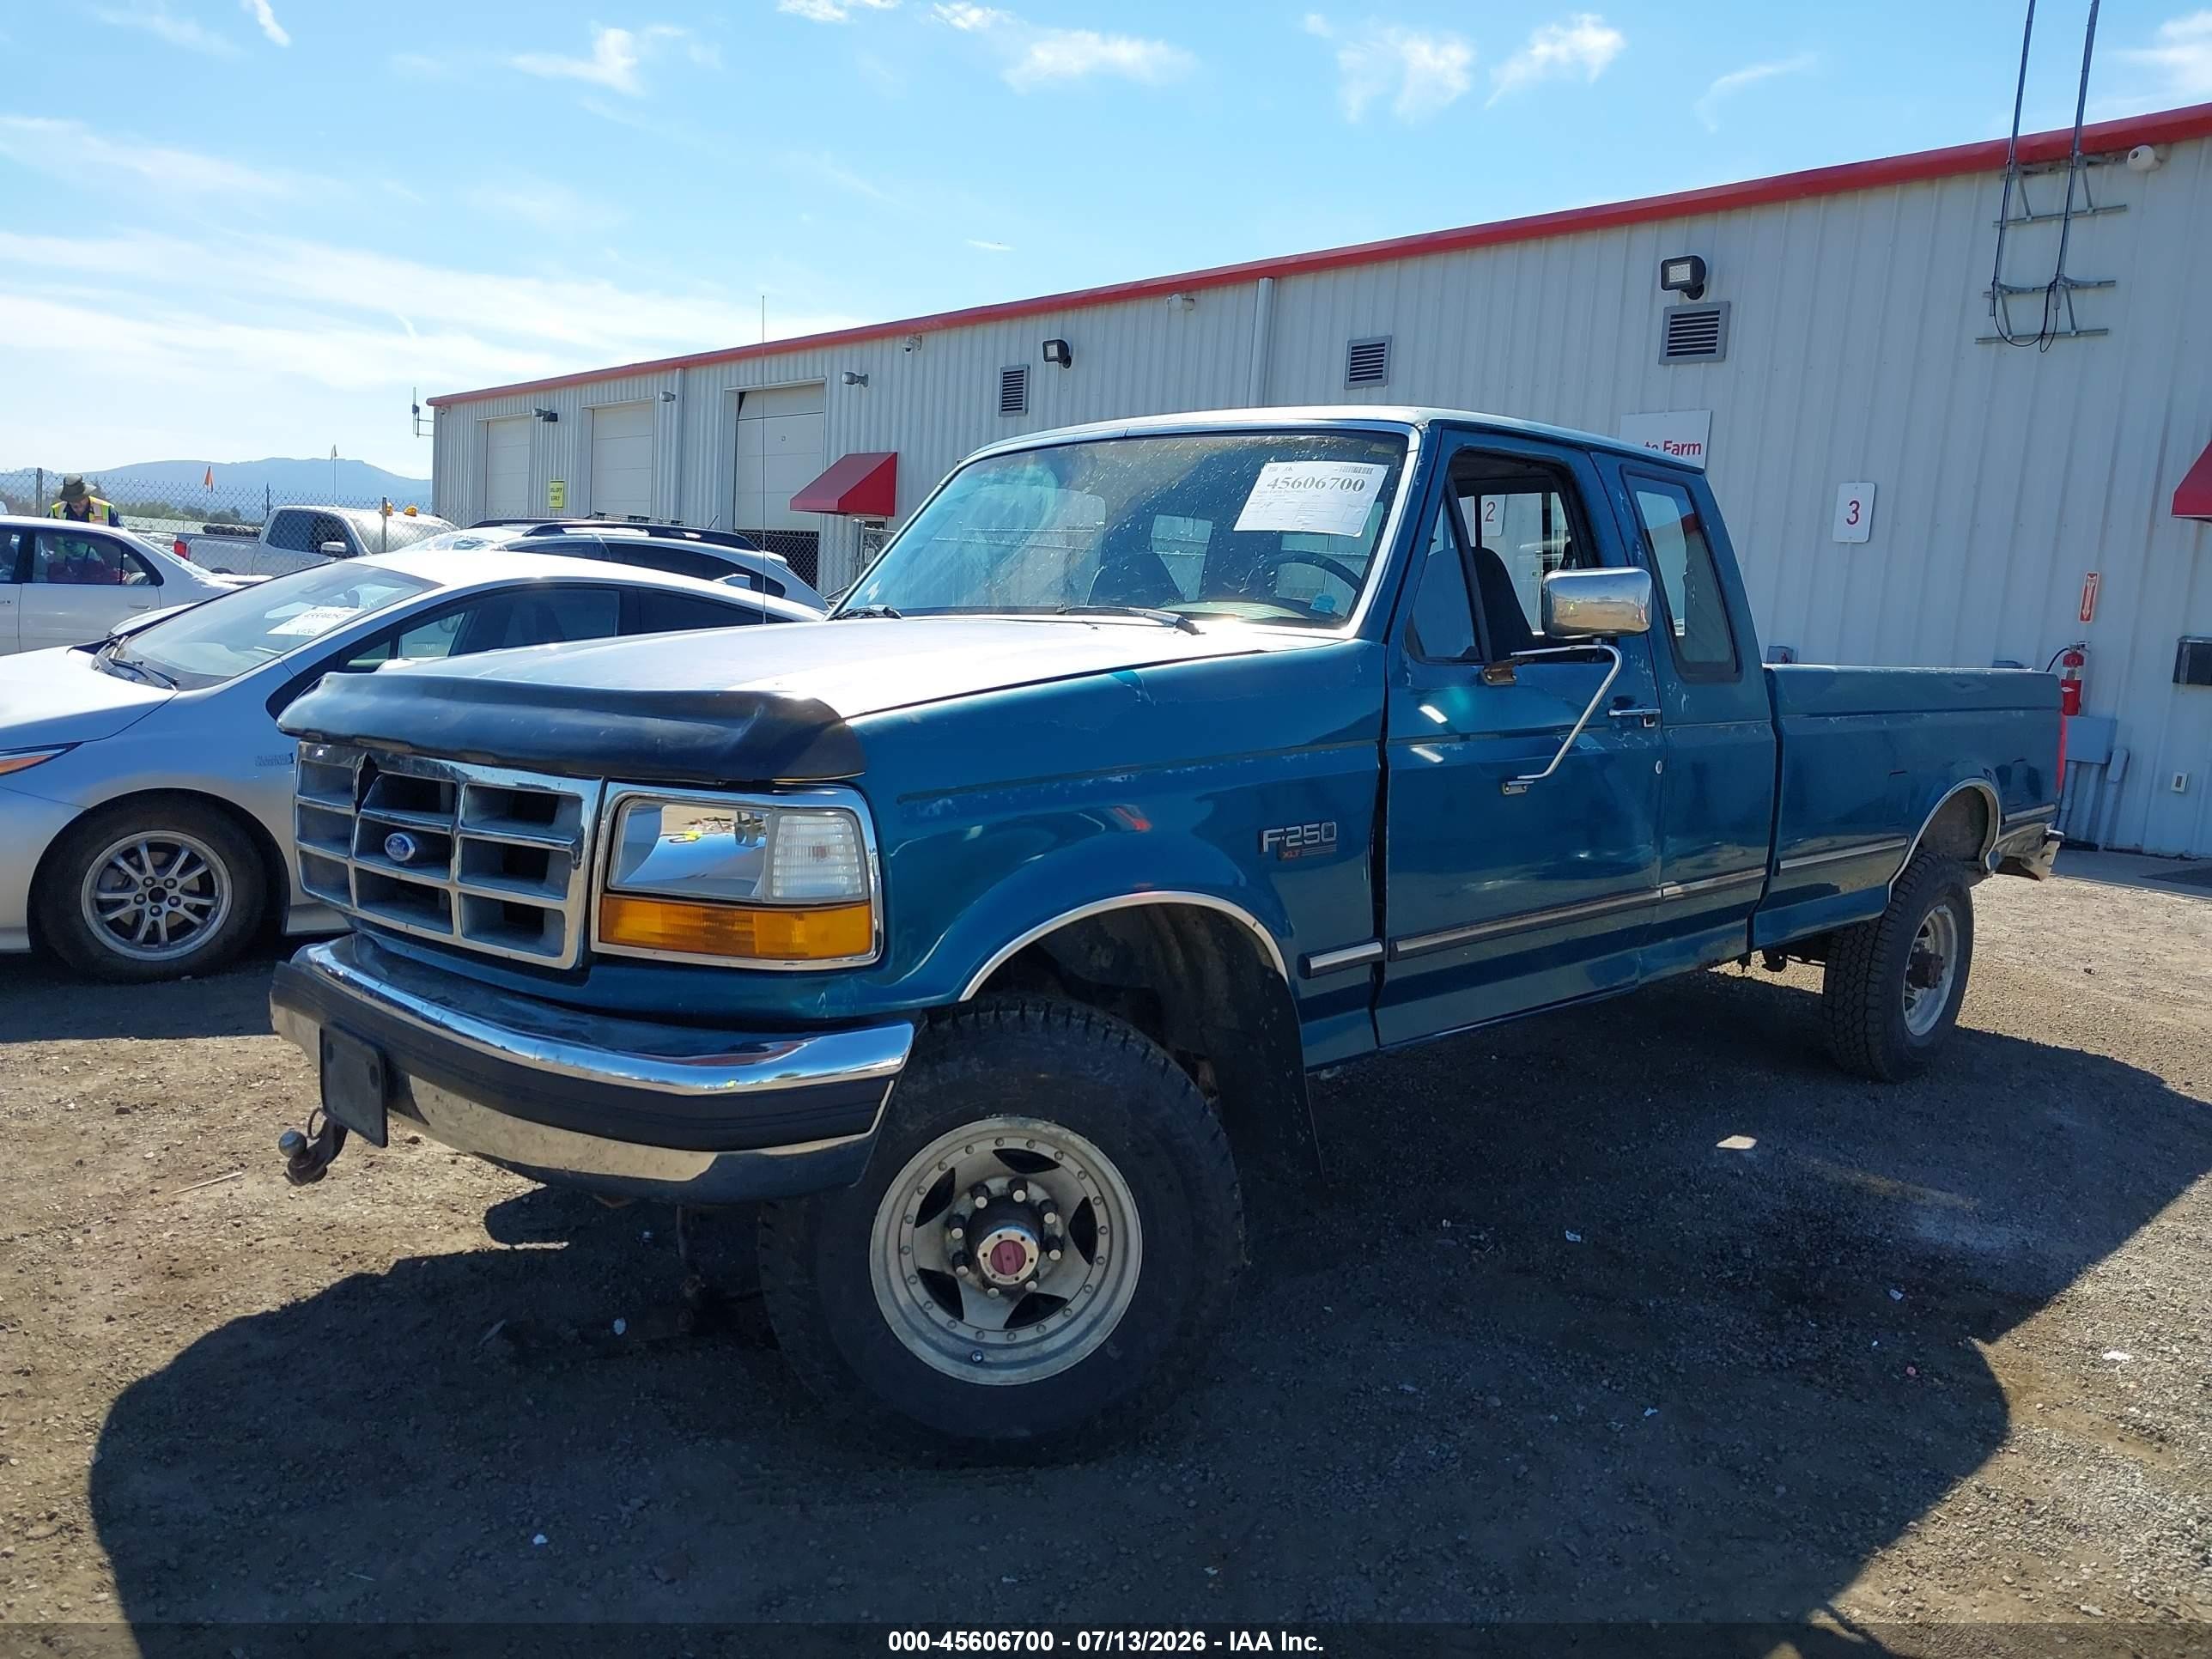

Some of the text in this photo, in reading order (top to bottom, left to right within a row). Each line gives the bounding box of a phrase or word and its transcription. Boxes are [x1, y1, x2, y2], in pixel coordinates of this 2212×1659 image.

[1663, 440, 1702, 456] Farm
[1267, 477, 1365, 492] 45606700
[1484, 501, 1496, 522] 2
[1846, 500, 1860, 526] 3
